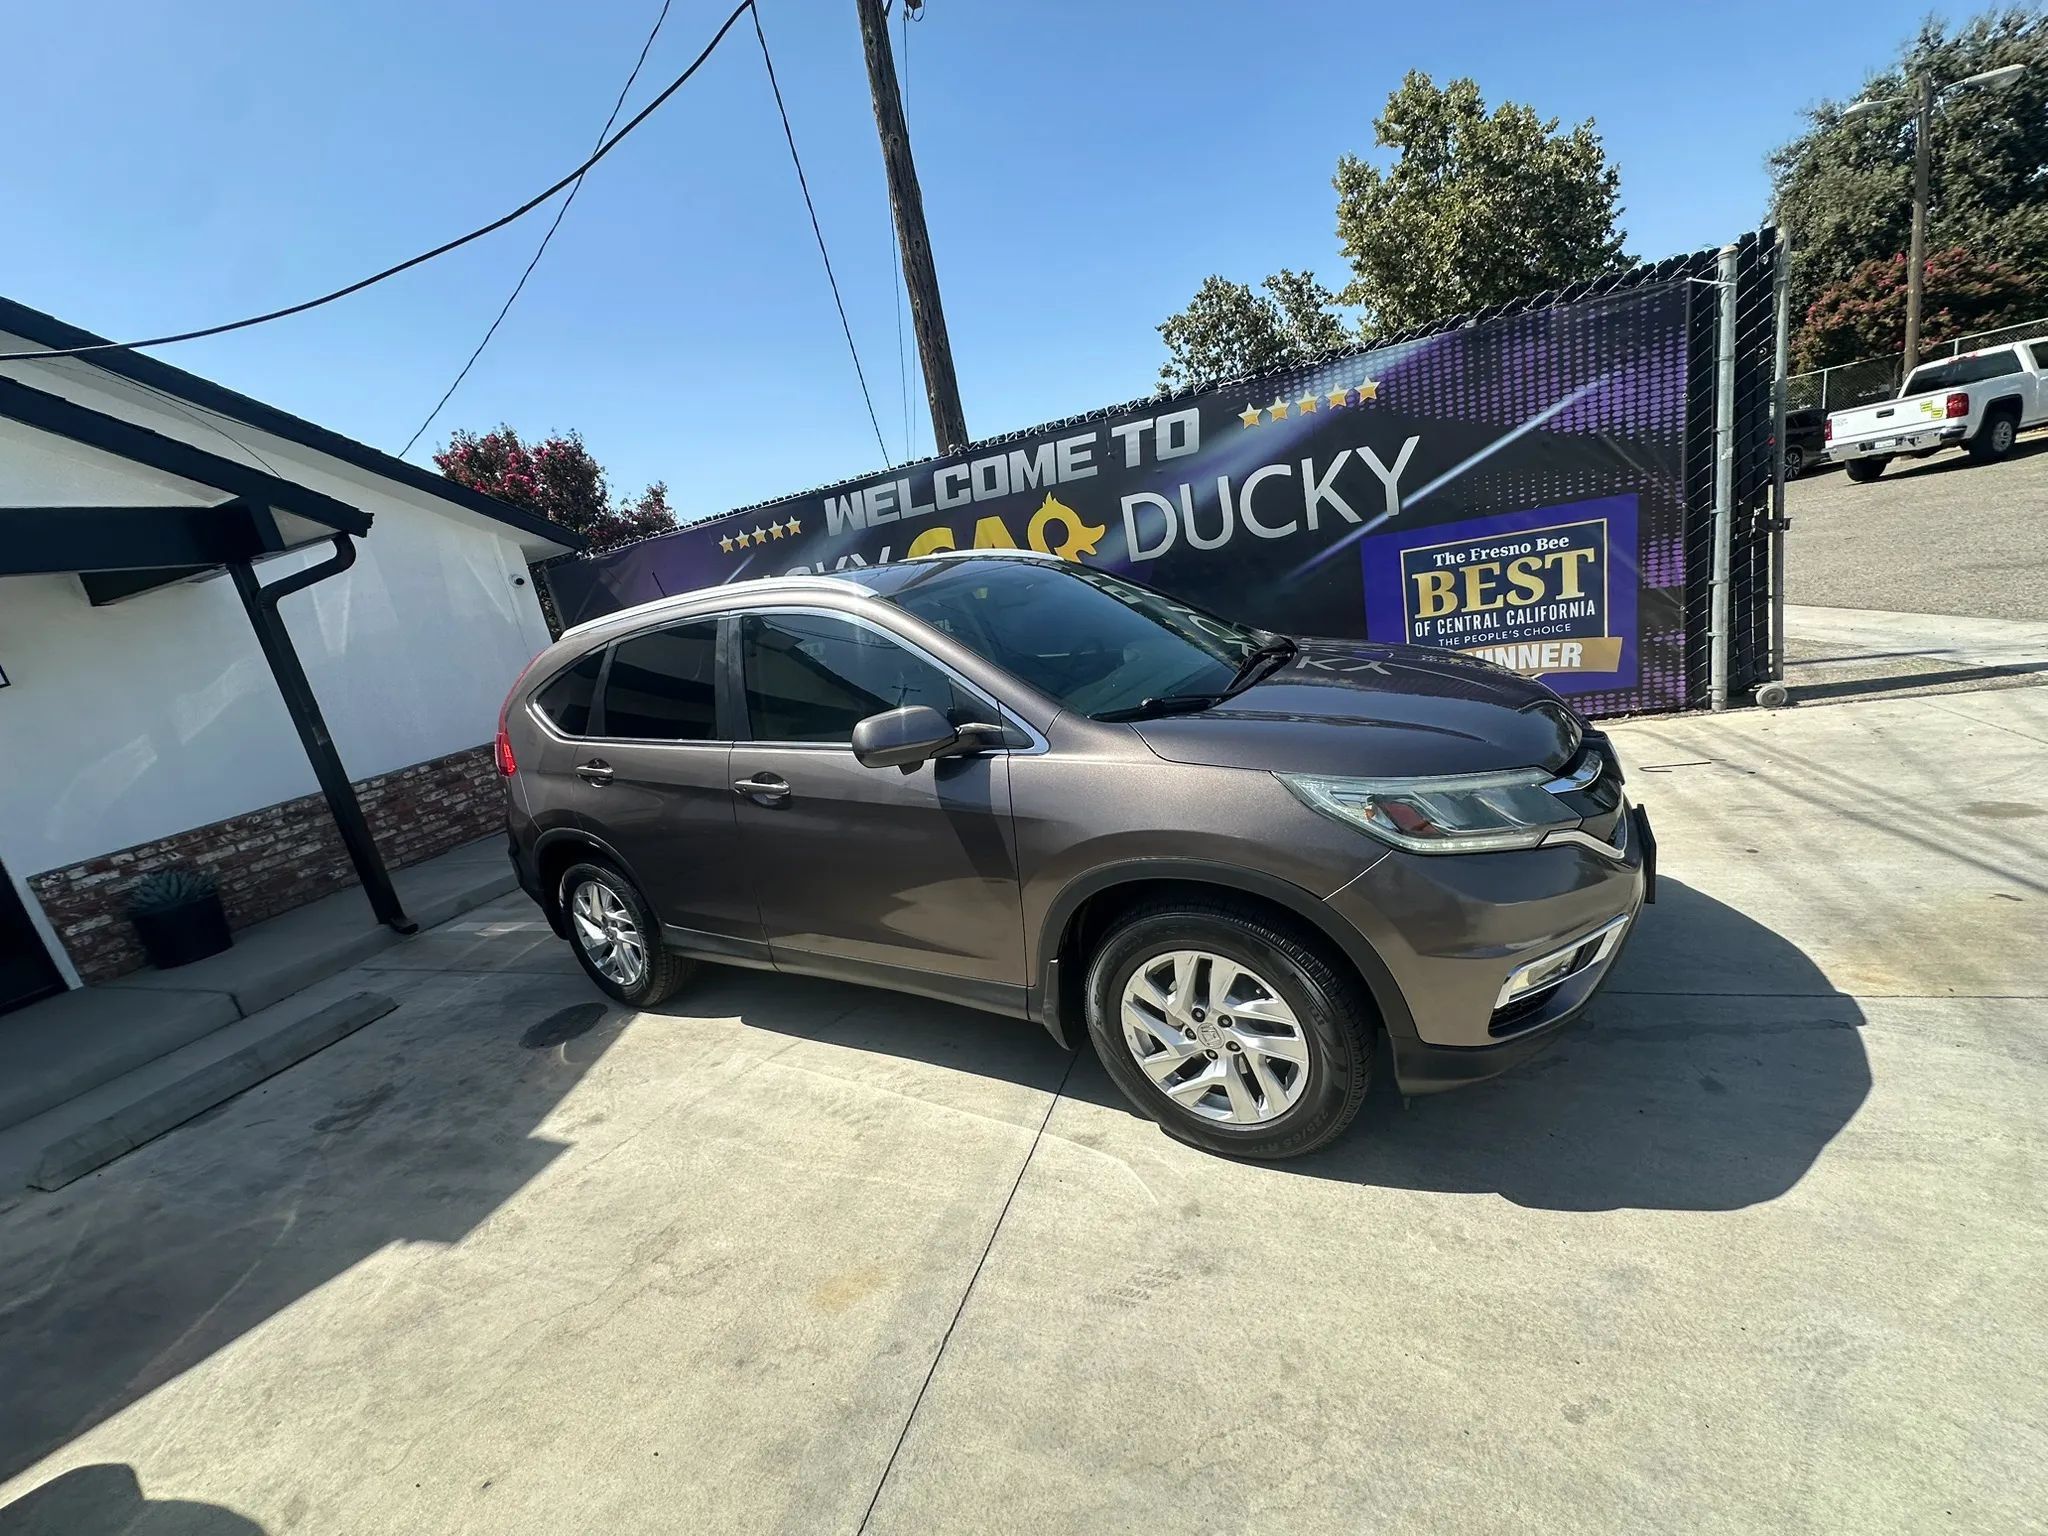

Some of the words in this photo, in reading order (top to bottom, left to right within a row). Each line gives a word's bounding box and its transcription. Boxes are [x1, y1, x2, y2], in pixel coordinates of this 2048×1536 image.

[824, 439, 1098, 536] WELCOME
[1112, 407, 1201, 469] TO
[1120, 435, 1421, 563] DUCKY
[1433, 551, 1466, 567] The
[1471, 542, 1531, 560] Fresno
[1535, 536, 1570, 551] Bee
[1412, 548, 1595, 618] BEST
[1415, 620, 1431, 637] OF
[1437, 612, 1500, 634] CENTRAL
[1506, 599, 1596, 626] CALIFORNIA
[1438, 638, 1460, 647] THE
[1524, 623, 1571, 637] CHOICE
